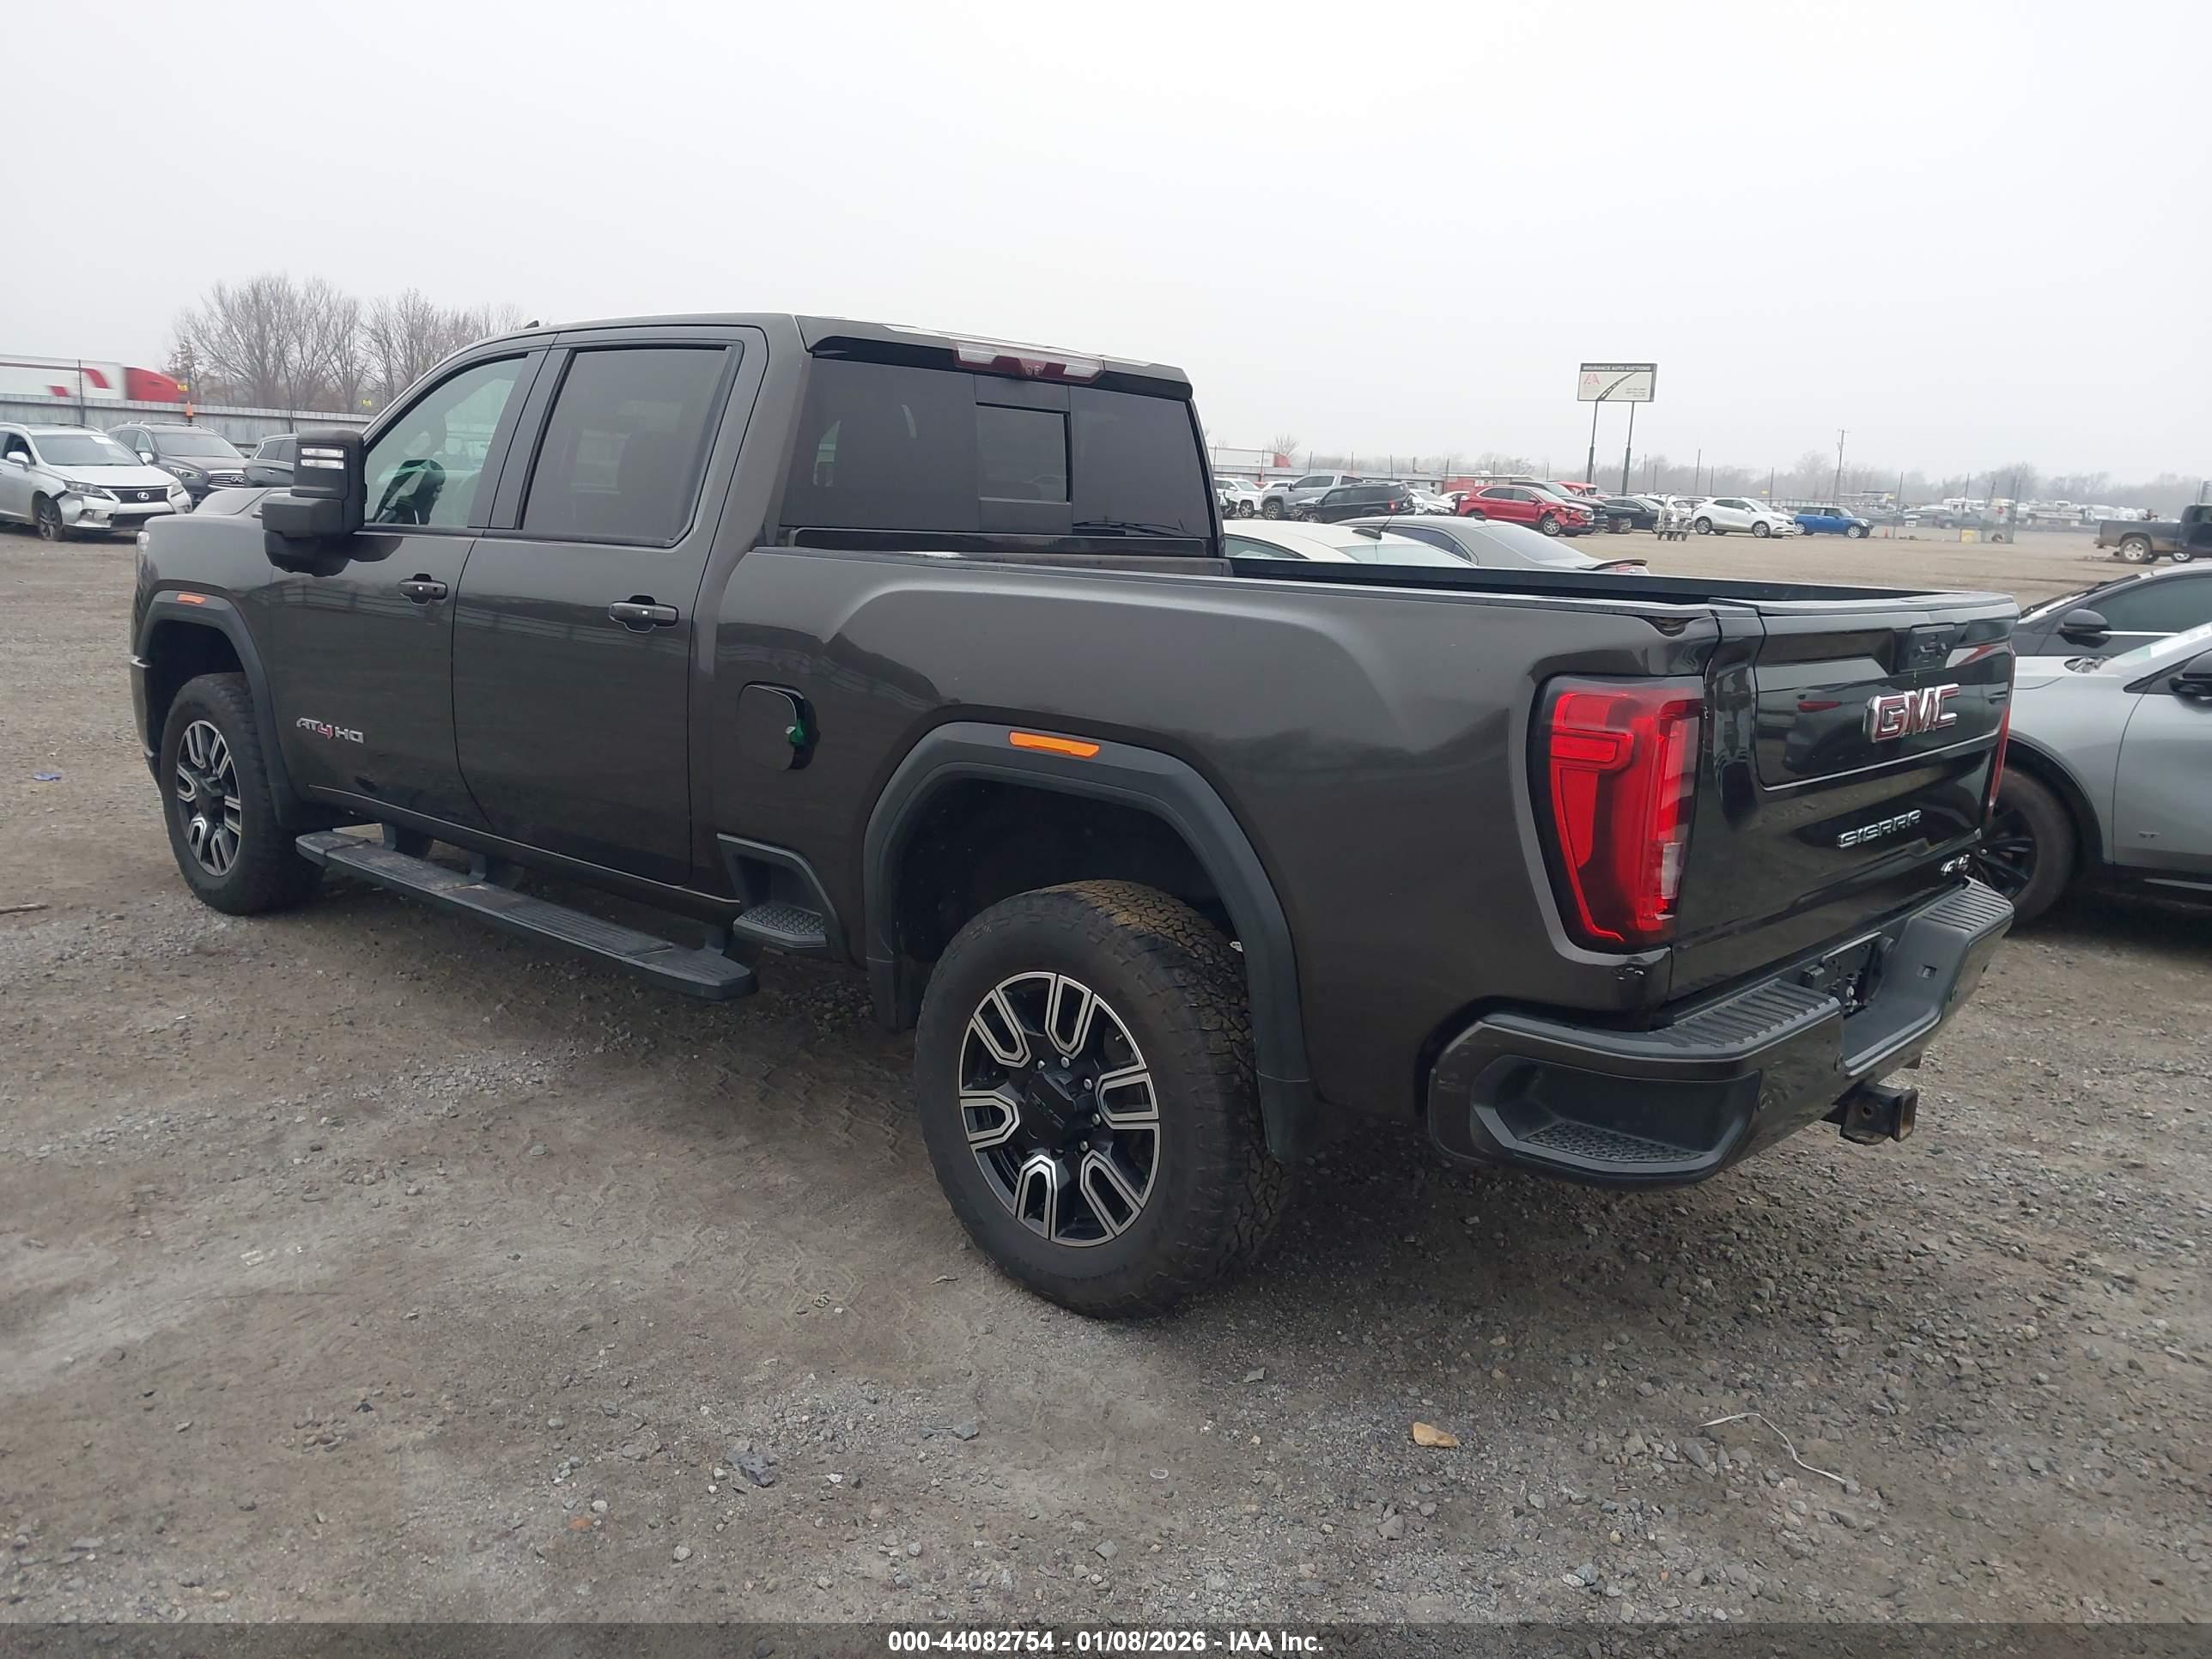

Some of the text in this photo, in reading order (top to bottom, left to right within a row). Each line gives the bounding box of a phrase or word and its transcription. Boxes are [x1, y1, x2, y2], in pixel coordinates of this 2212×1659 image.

[295, 717, 365, 744] AT4 HD
[1862, 683, 1960, 743] GMC
[1837, 809, 1922, 848] SIERRA
